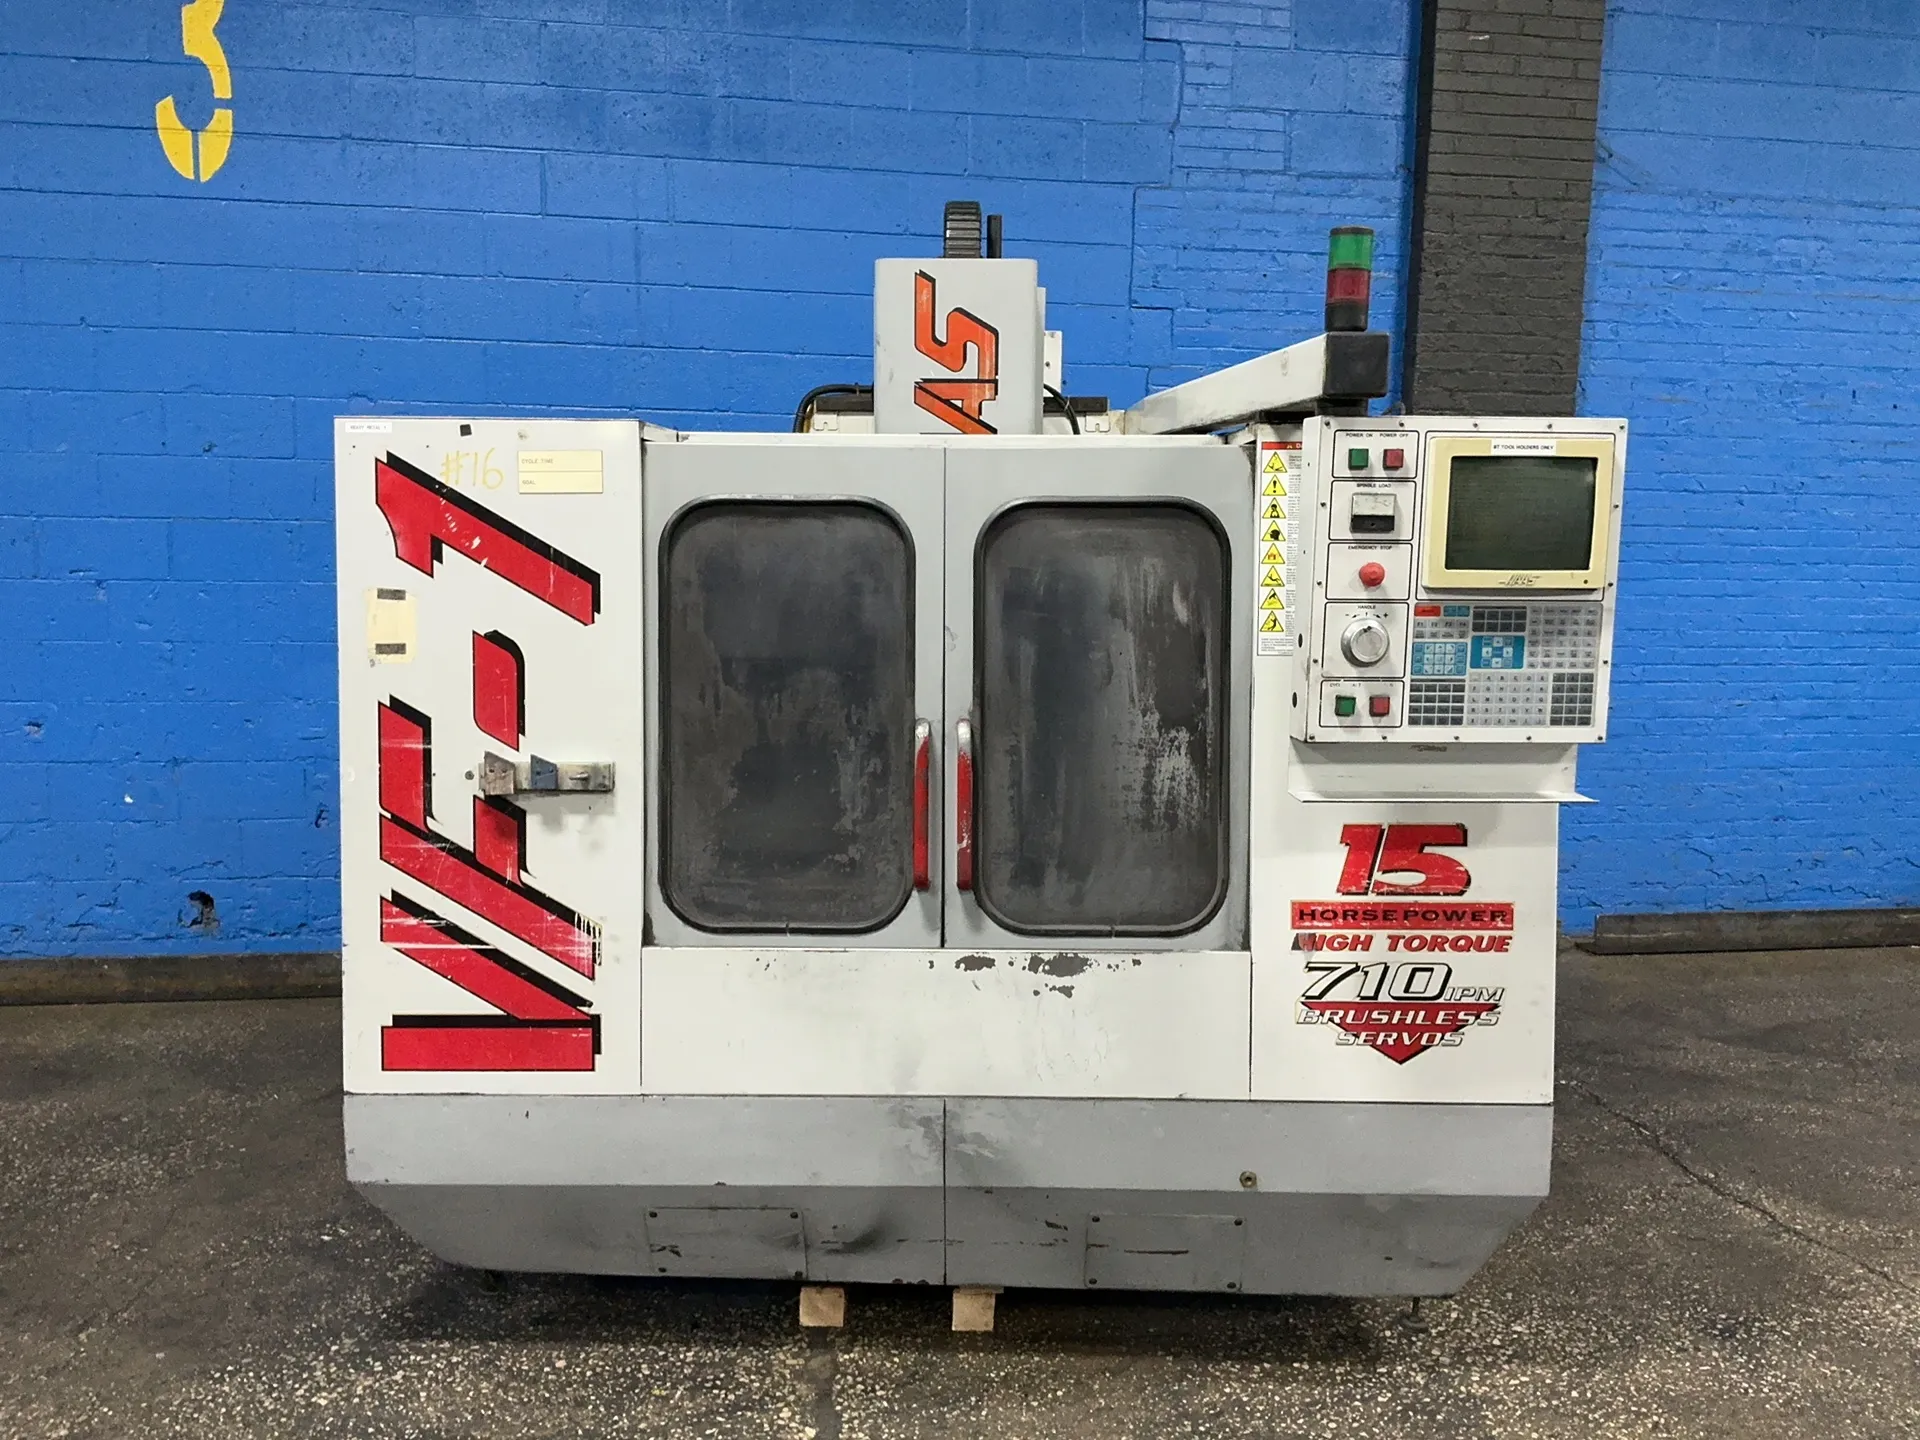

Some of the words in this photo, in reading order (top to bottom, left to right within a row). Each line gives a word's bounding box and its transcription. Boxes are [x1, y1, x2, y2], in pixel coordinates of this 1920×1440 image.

[913, 268, 999, 434] AS
[1336, 823, 1471, 896] 15
[1299, 908, 1508, 923] HORSEPOWER
[1387, 934, 1512, 953] TORQUE
[1301, 961, 1453, 1001] 710
[1443, 987, 1505, 1002] IPM
[1297, 1008, 1501, 1026] BRUSHLESS
[1335, 1031, 1465, 1047] SERVOS
